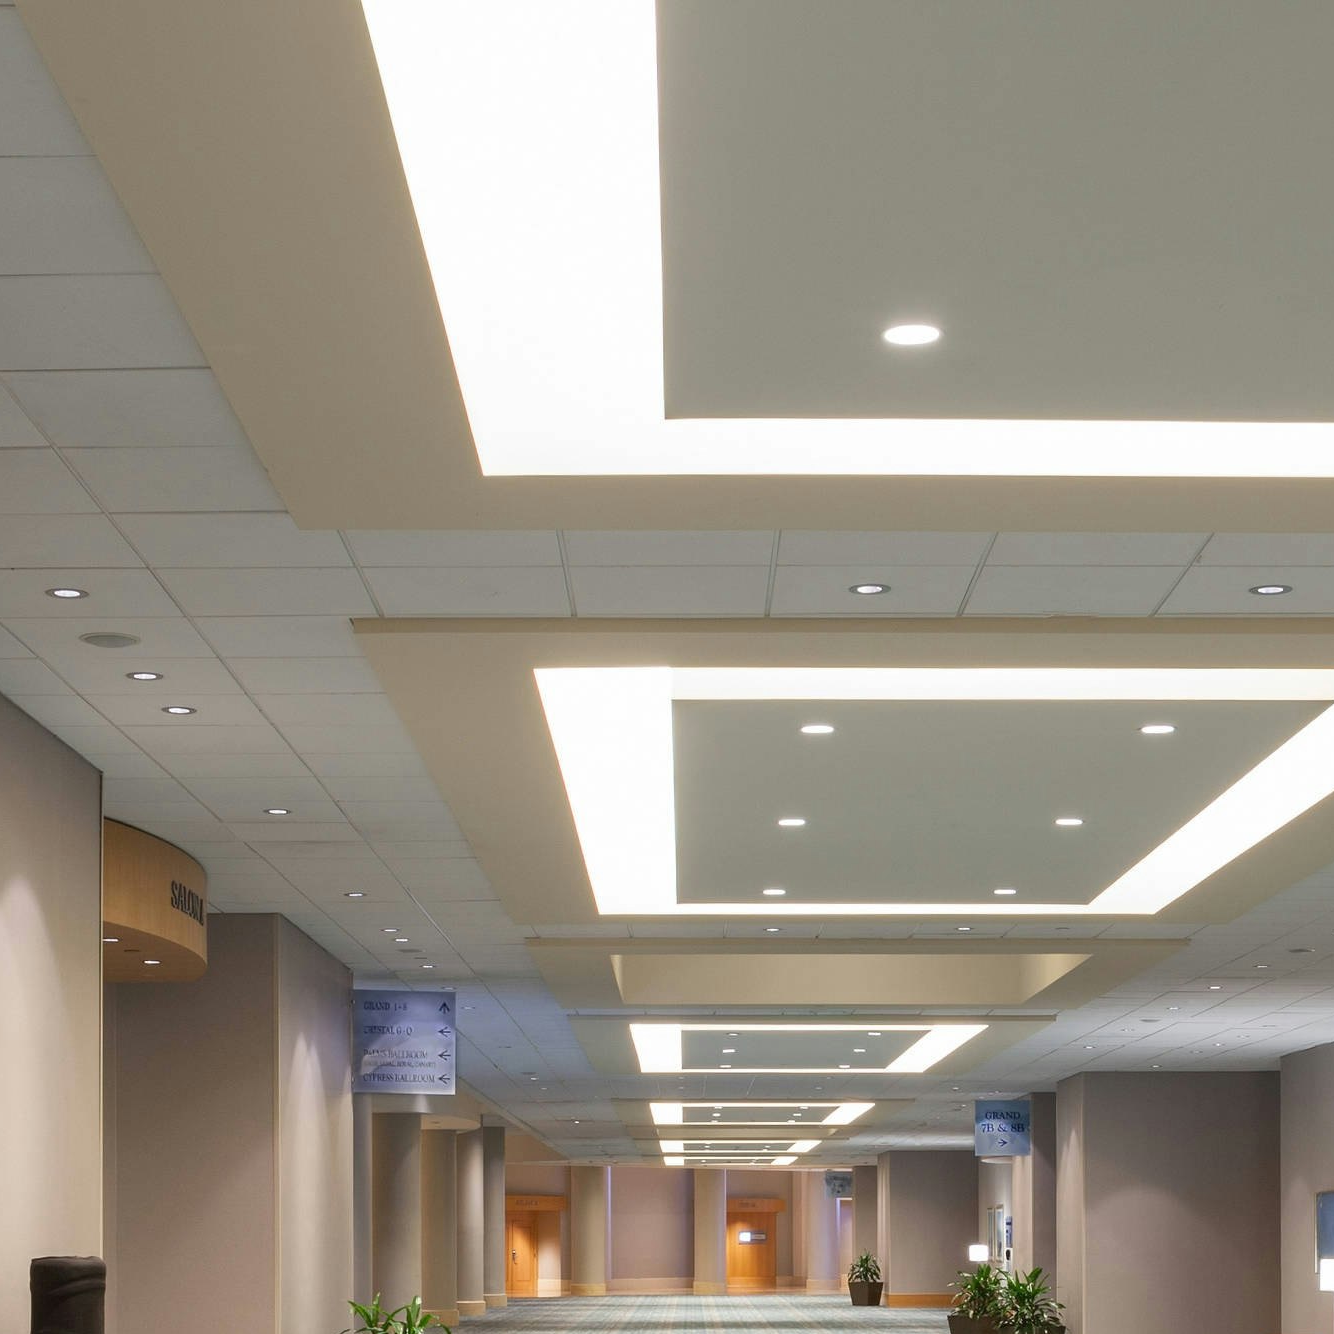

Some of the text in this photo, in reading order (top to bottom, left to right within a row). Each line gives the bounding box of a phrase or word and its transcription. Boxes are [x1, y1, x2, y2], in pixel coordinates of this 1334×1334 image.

[363, 1001, 390, 1011] GRAND
[985, 1111, 1021, 1120] GRAND
[981, 1123, 1025, 1133] 7B & 8B
